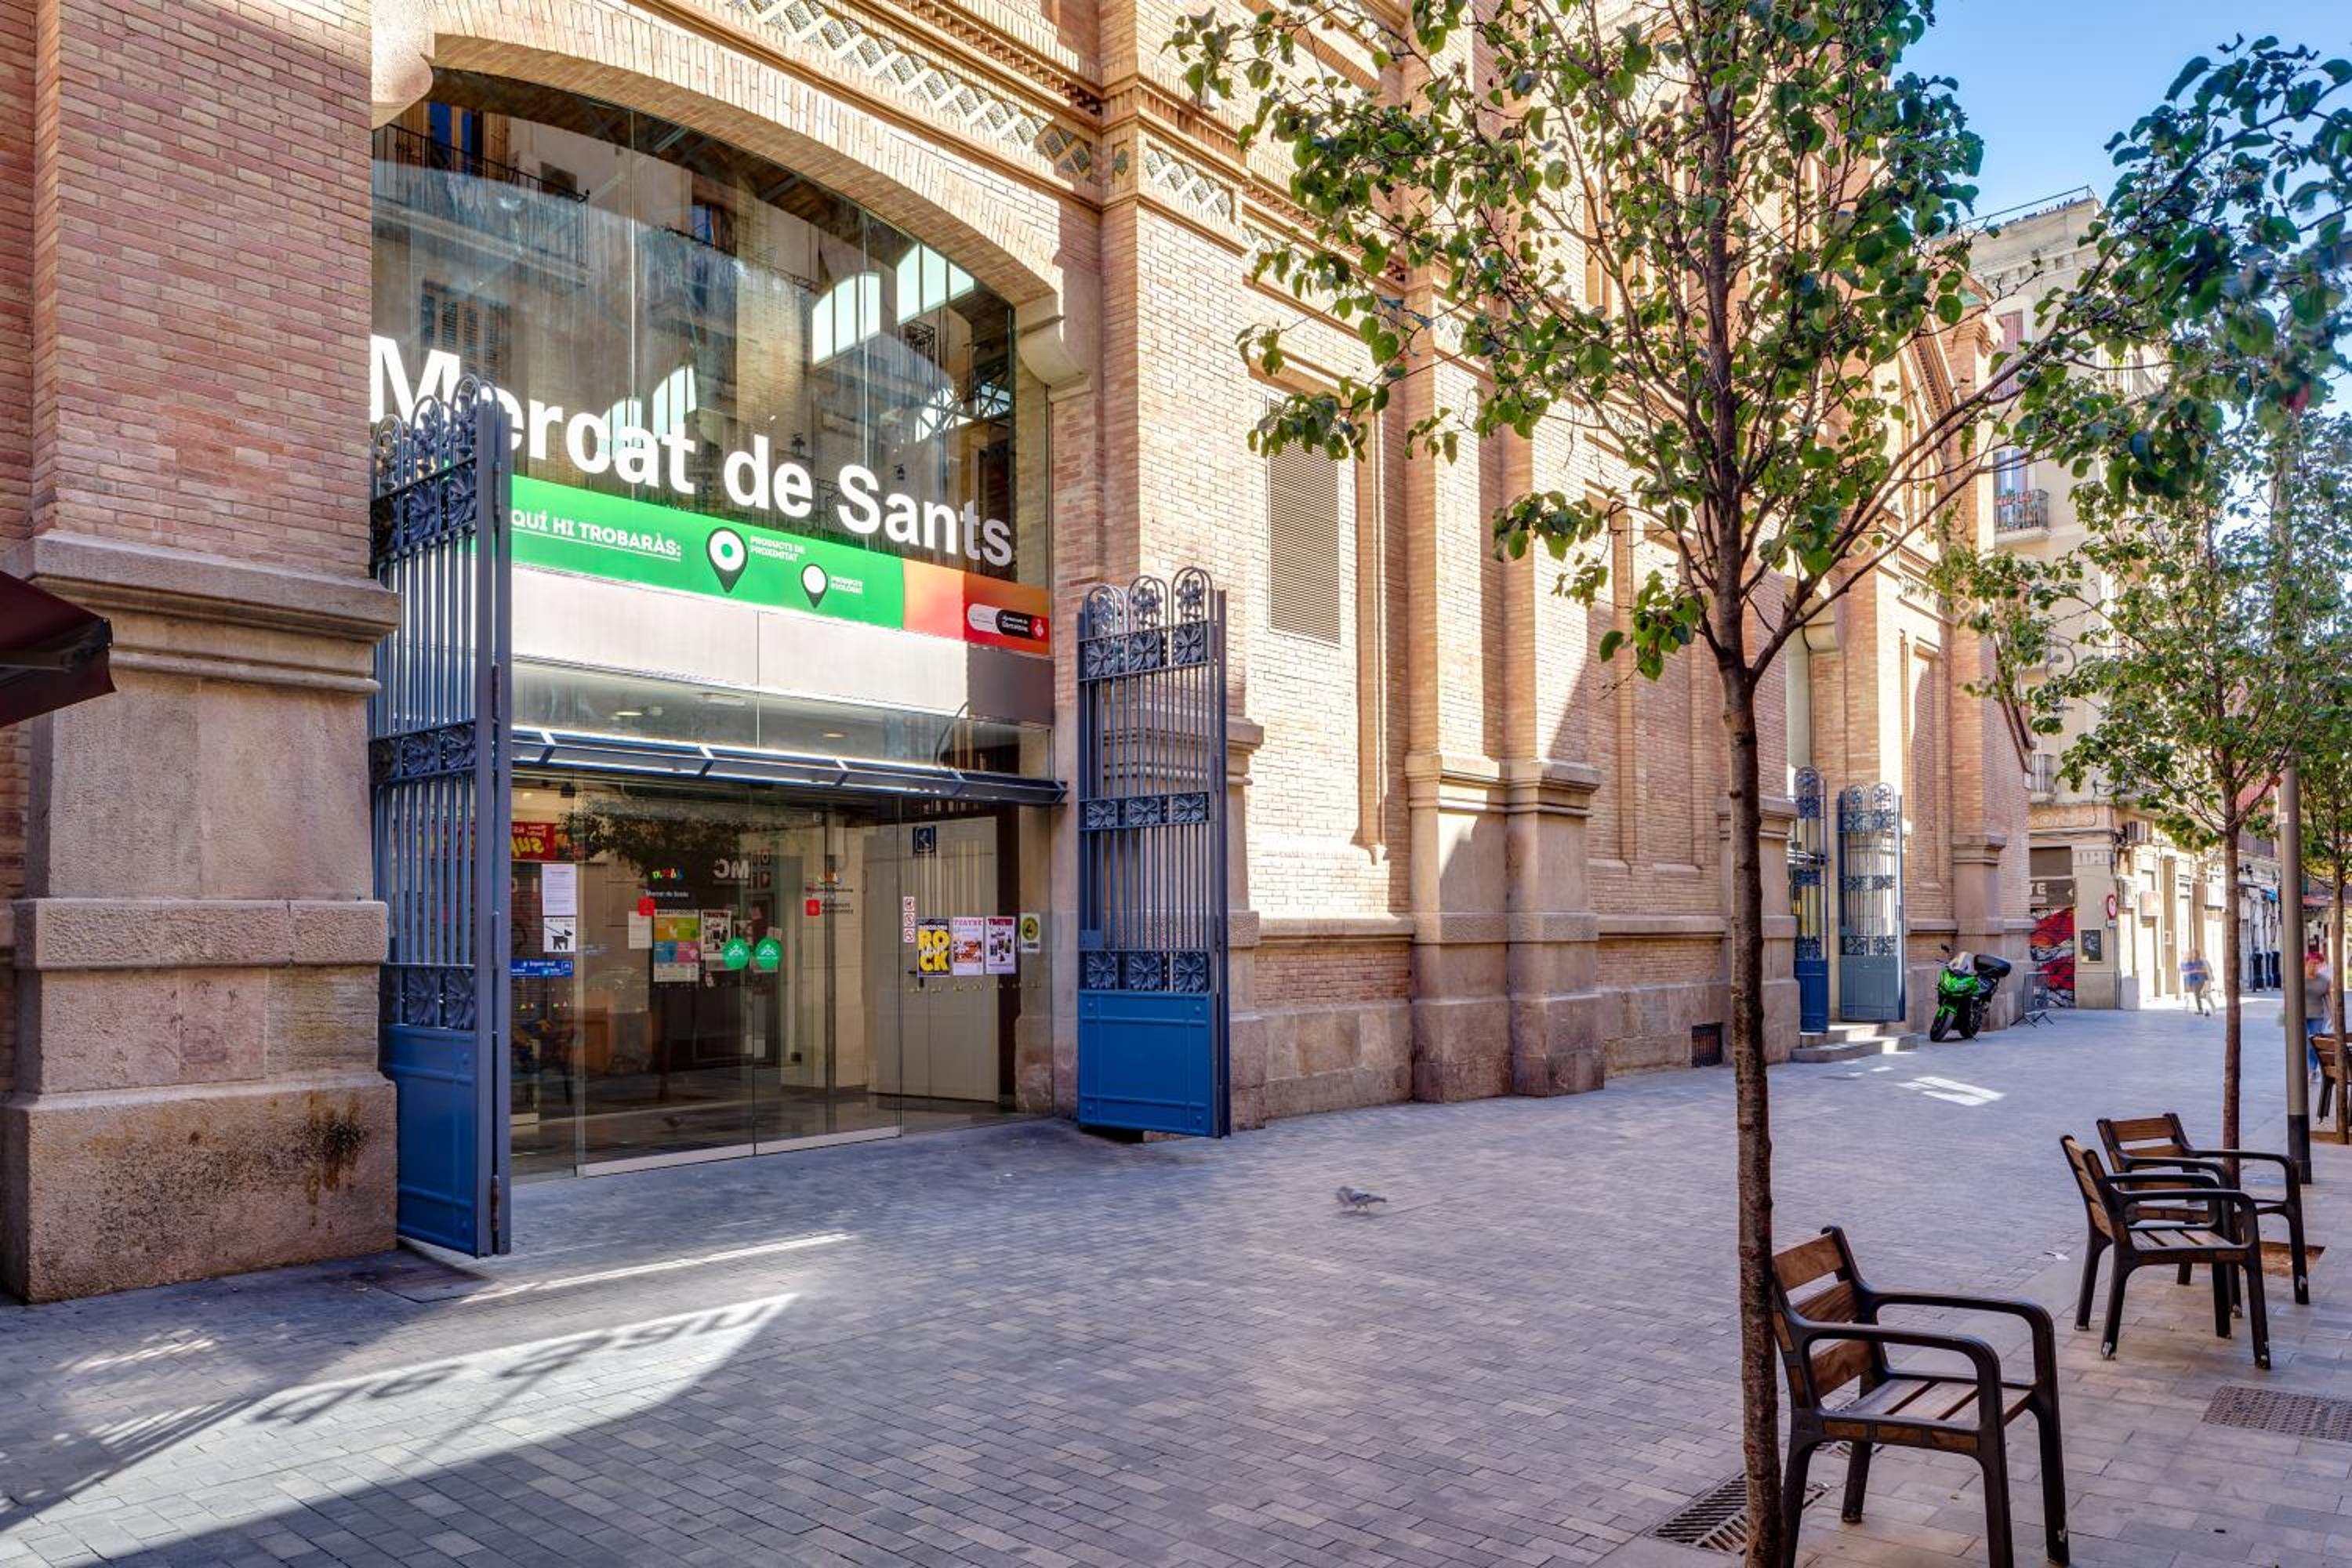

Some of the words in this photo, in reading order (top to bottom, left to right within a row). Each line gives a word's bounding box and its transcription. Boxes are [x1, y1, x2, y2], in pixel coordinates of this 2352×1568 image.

[512, 510, 548, 531] QUÍ
[552, 516, 575, 537] HI
[579, 521, 681, 557] TROBARÀS:
[724, 434, 813, 517] de
[837, 464, 1012, 567] Sants
